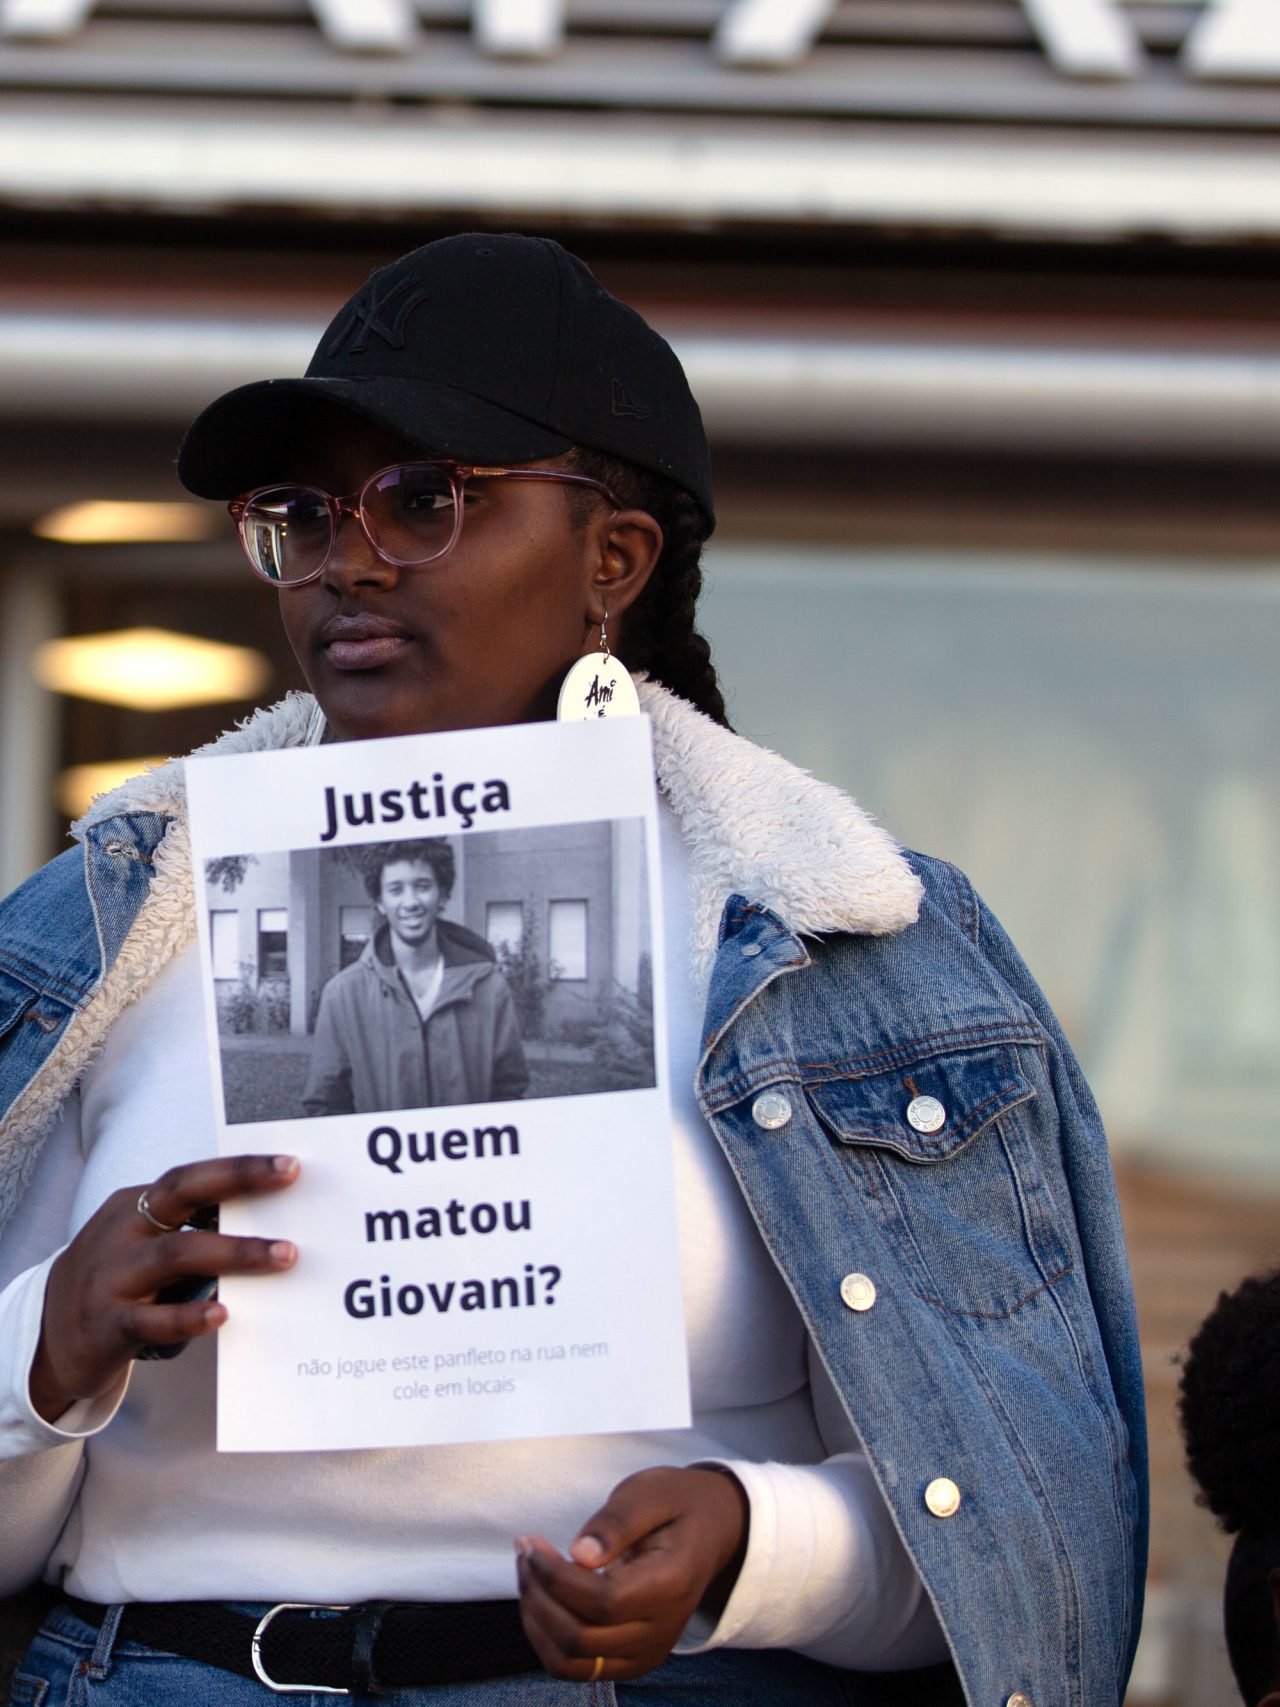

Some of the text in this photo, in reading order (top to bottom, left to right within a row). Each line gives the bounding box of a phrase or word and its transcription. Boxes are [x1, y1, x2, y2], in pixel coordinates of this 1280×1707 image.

[320, 773, 511, 842] Justiça
[367, 1125, 519, 1174] Quem
[365, 1200, 531, 1242] matou
[343, 1264, 561, 1319] Giovani?
[297, 1340, 609, 1379] não jogue este panfleto na rua nem
[392, 1375, 517, 1401] cole em locais
